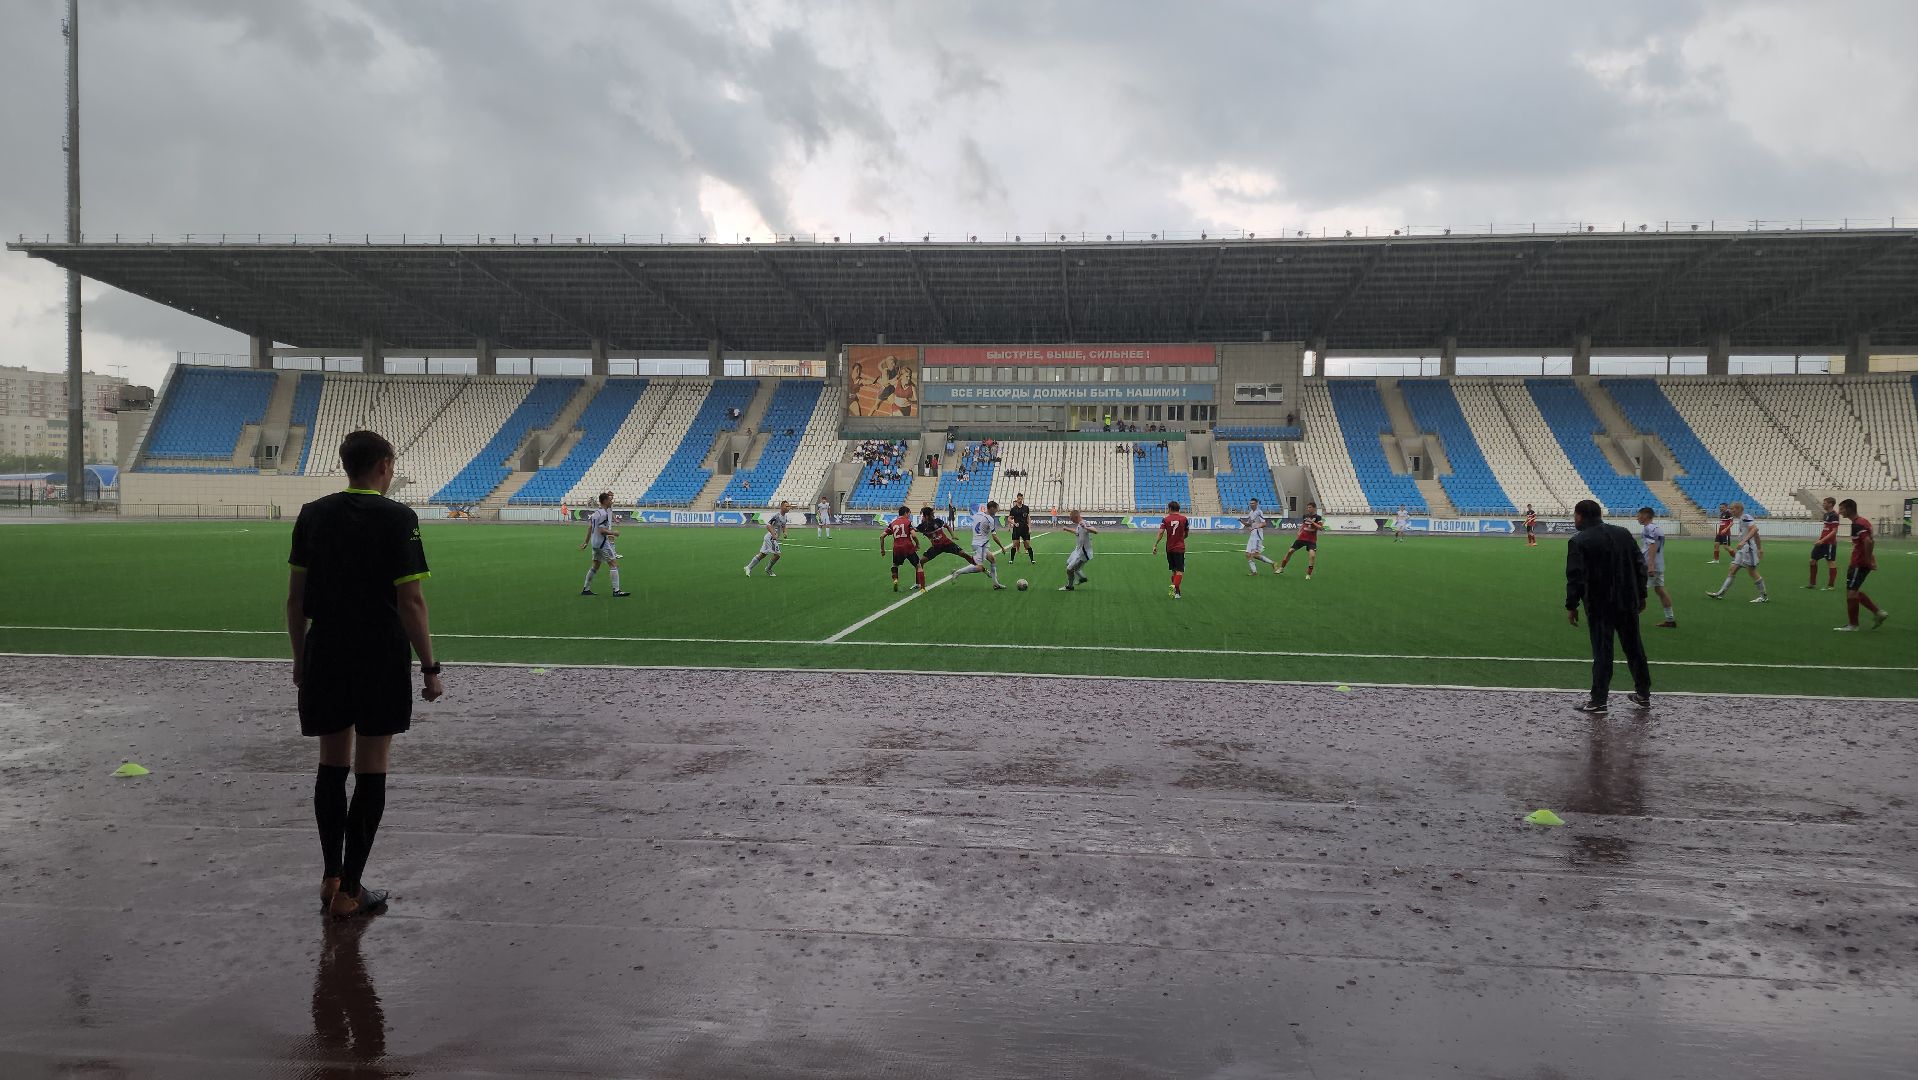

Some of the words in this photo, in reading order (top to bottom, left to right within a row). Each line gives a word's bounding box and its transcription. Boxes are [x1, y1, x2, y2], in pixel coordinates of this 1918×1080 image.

[986, 350, 1043, 360] БЫСТРЕЕ,
[1046, 350, 1086, 360] ВЫШЕ,
[1089, 350, 1144, 359] СИЛЬНЕЕ
[951, 388, 973, 398] ВСЕ
[976, 388, 1030, 399] РЕКОРДЫ
[1033, 388, 1087, 399] ДОЛЖНЫ
[1090, 388, 1123, 398] БЫТЬ
[1126, 388, 1180, 397] НАШИМИ
[674, 512, 712, 523] ГАЗПРОМ
[892, 523, 908, 539] 21
[1170, 520, 1180, 536] 7
[1433, 520, 1476, 531] ГАЗПРОМ
